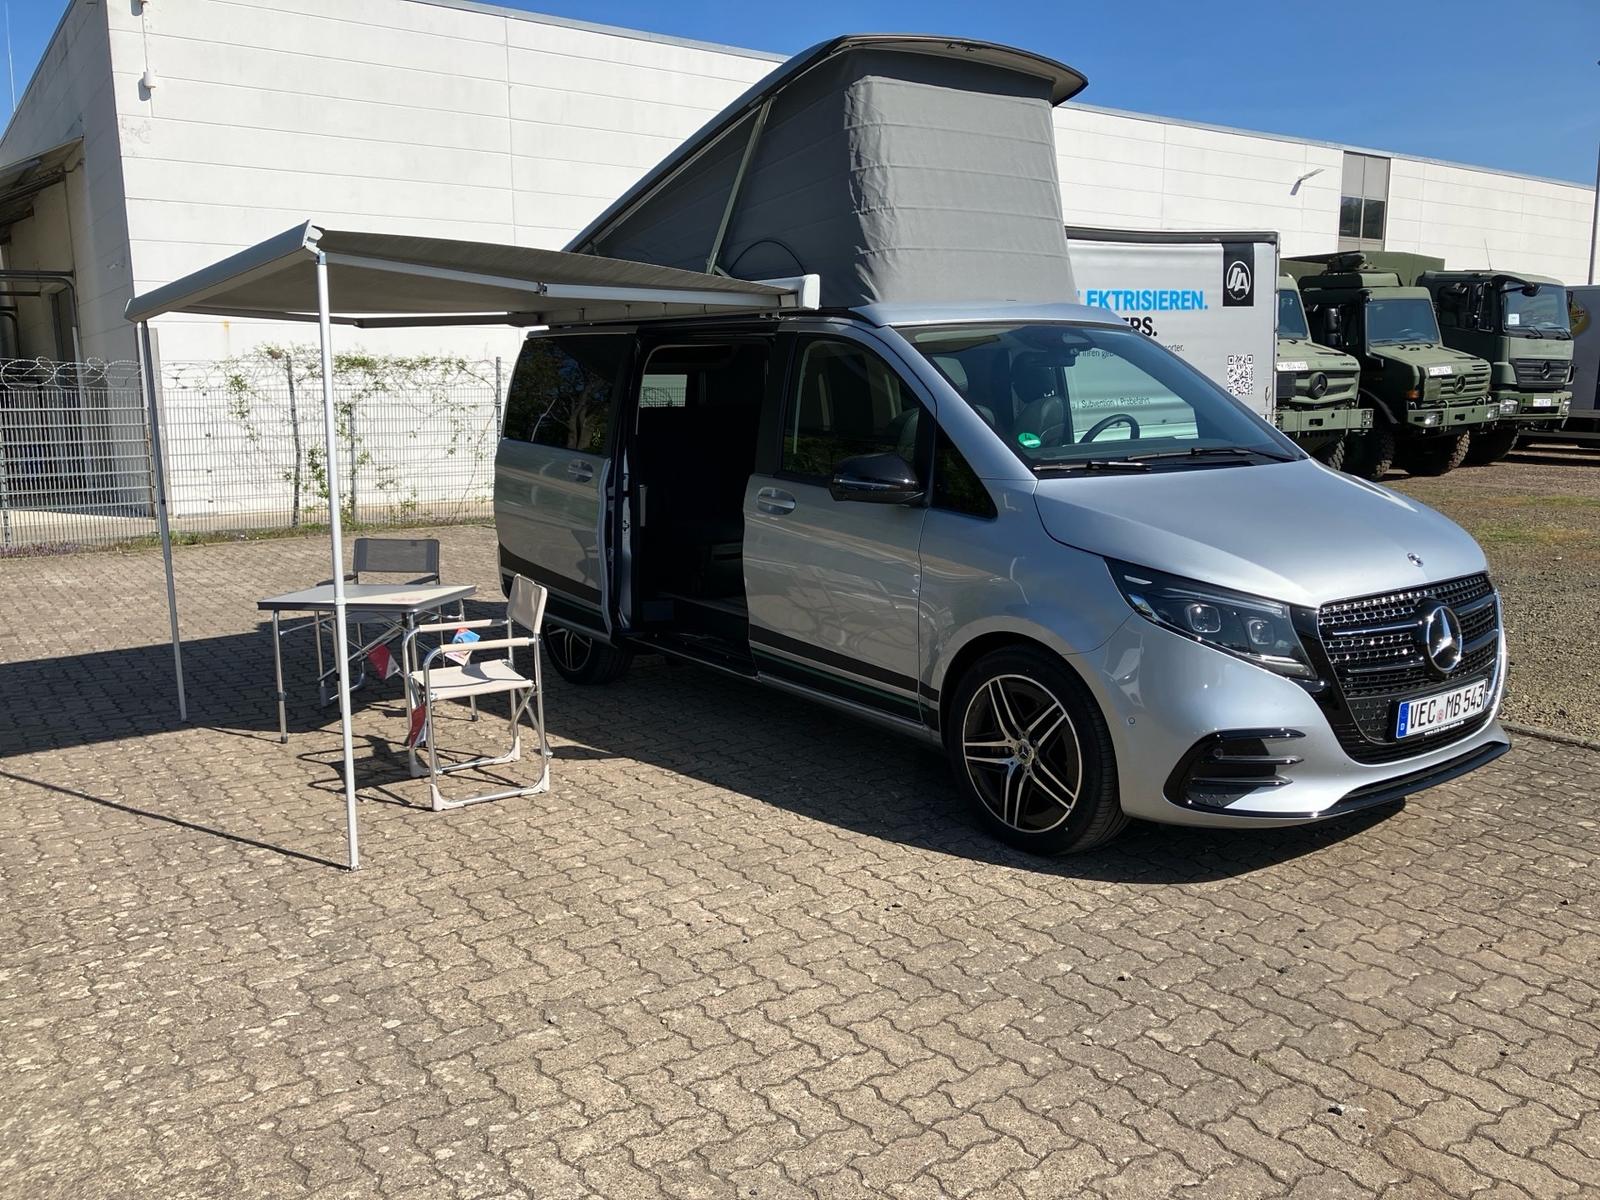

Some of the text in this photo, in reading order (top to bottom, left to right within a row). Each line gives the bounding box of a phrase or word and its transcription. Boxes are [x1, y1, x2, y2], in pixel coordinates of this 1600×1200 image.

[1077, 289, 1208, 311] EKTRISIEREN.
[1410, 699, 1437, 729] VEC
[1445, 692, 1462, 720] MB
[1463, 683, 1485, 713] 543
